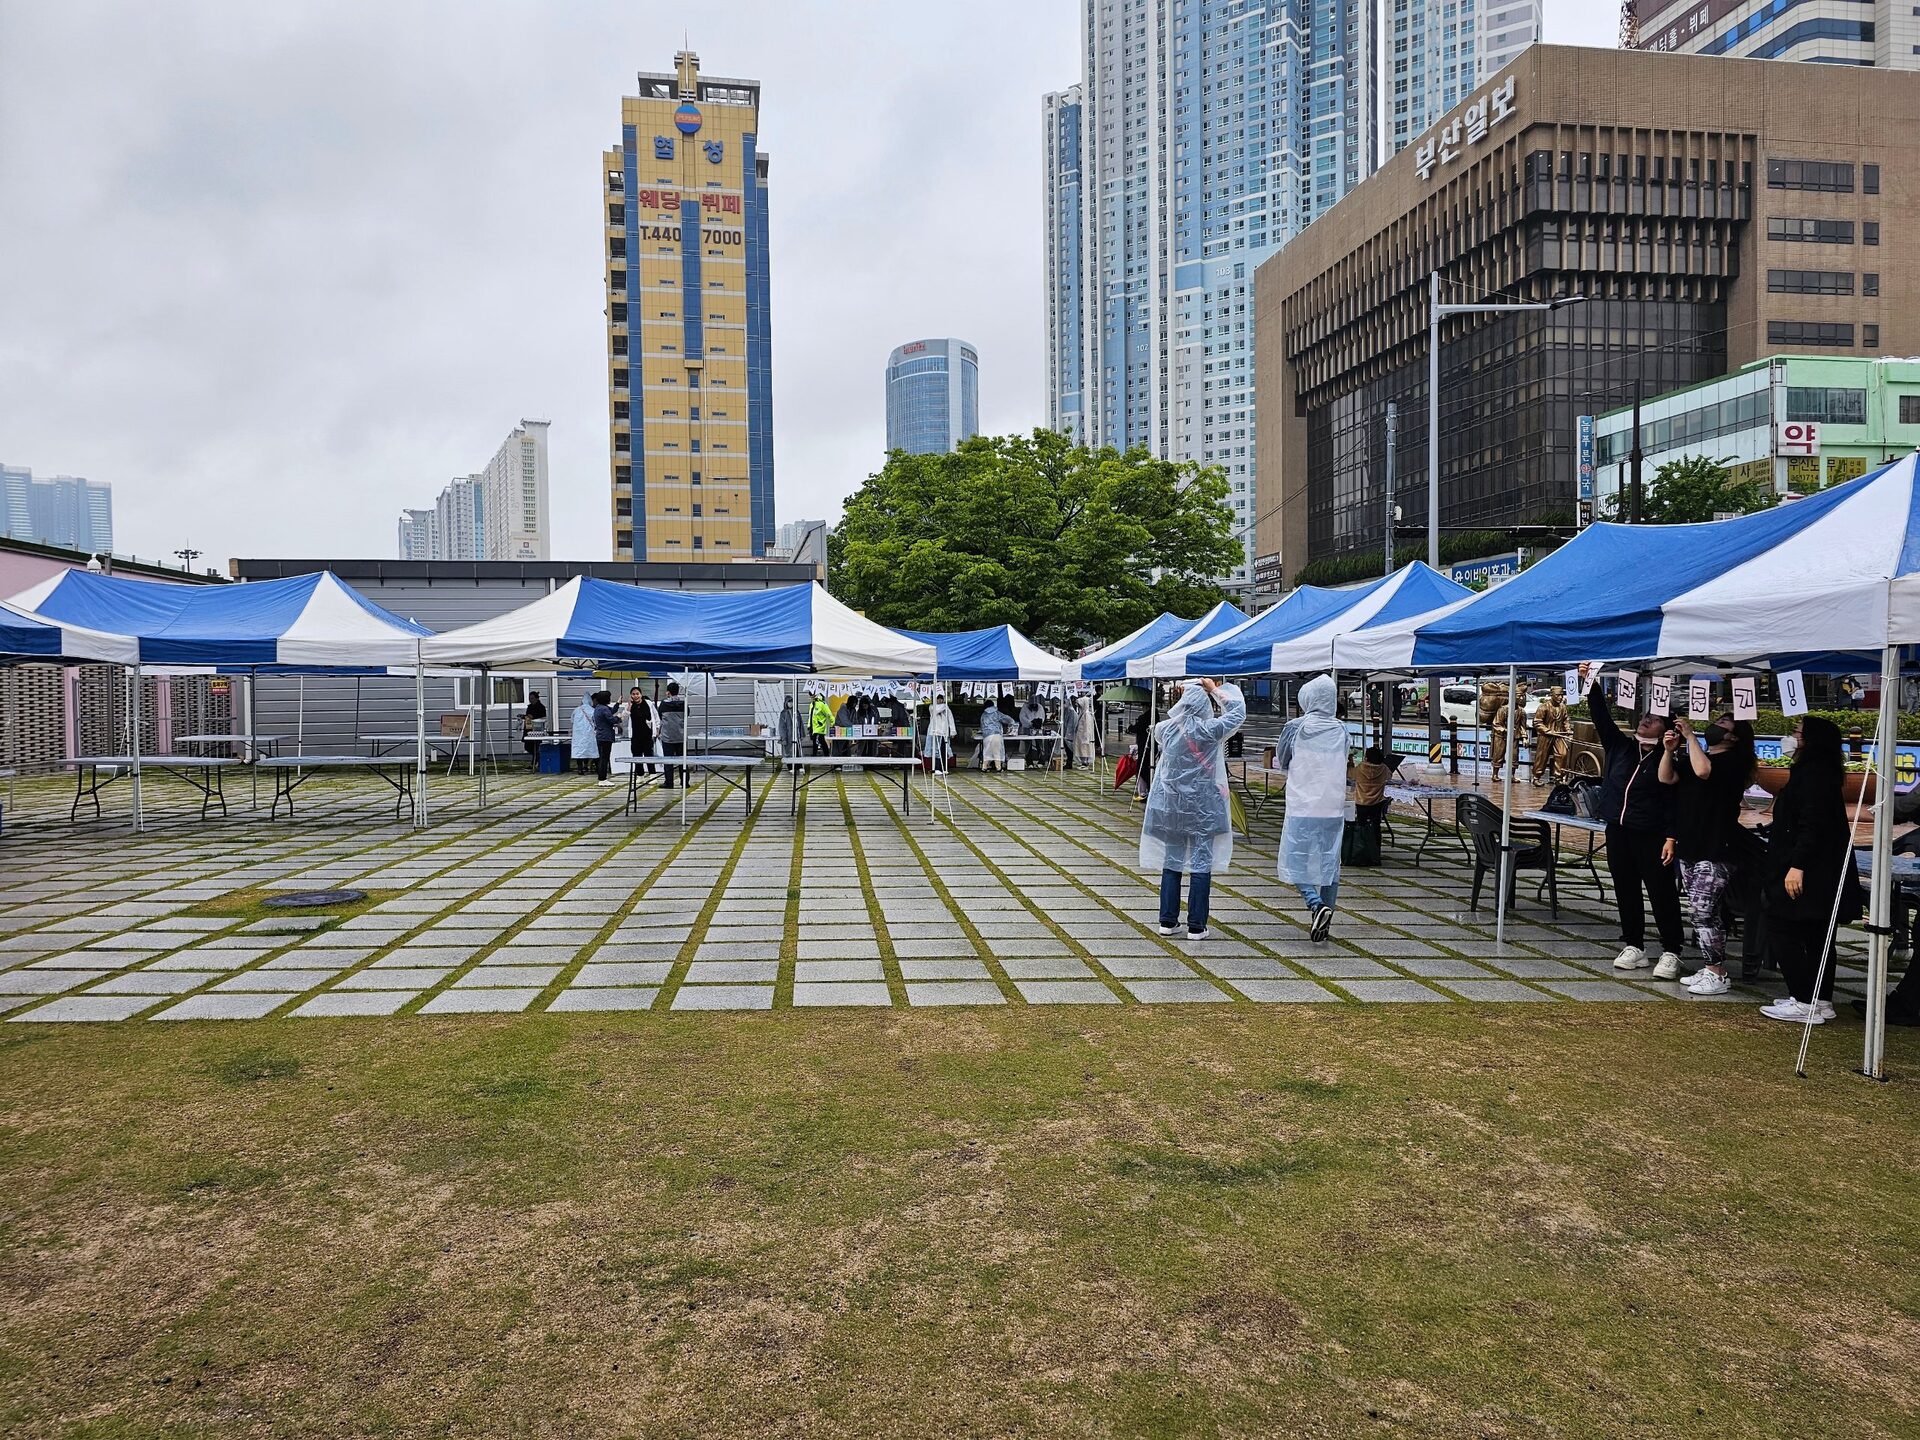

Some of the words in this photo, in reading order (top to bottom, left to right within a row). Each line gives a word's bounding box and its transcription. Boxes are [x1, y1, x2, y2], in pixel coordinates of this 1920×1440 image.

[1688, 4, 1709, 34] 뷔페
[1414, 75, 1516, 181] 부산일보
[639, 189, 681, 211] 웨딩
[701, 193, 741, 215] 뷔페
[640, 225, 682, 243] T.440
[702, 229, 742, 246] 7000
[1216, 267, 1231, 277] 103
[1136, 343, 1149, 352] 102
[1785, 425, 1816, 454] 약
[1580, 420, 1592, 491] 늘푸른약국
[807, 680, 860, 692] 아메리카노
[865, 680, 899, 694] 시원한
